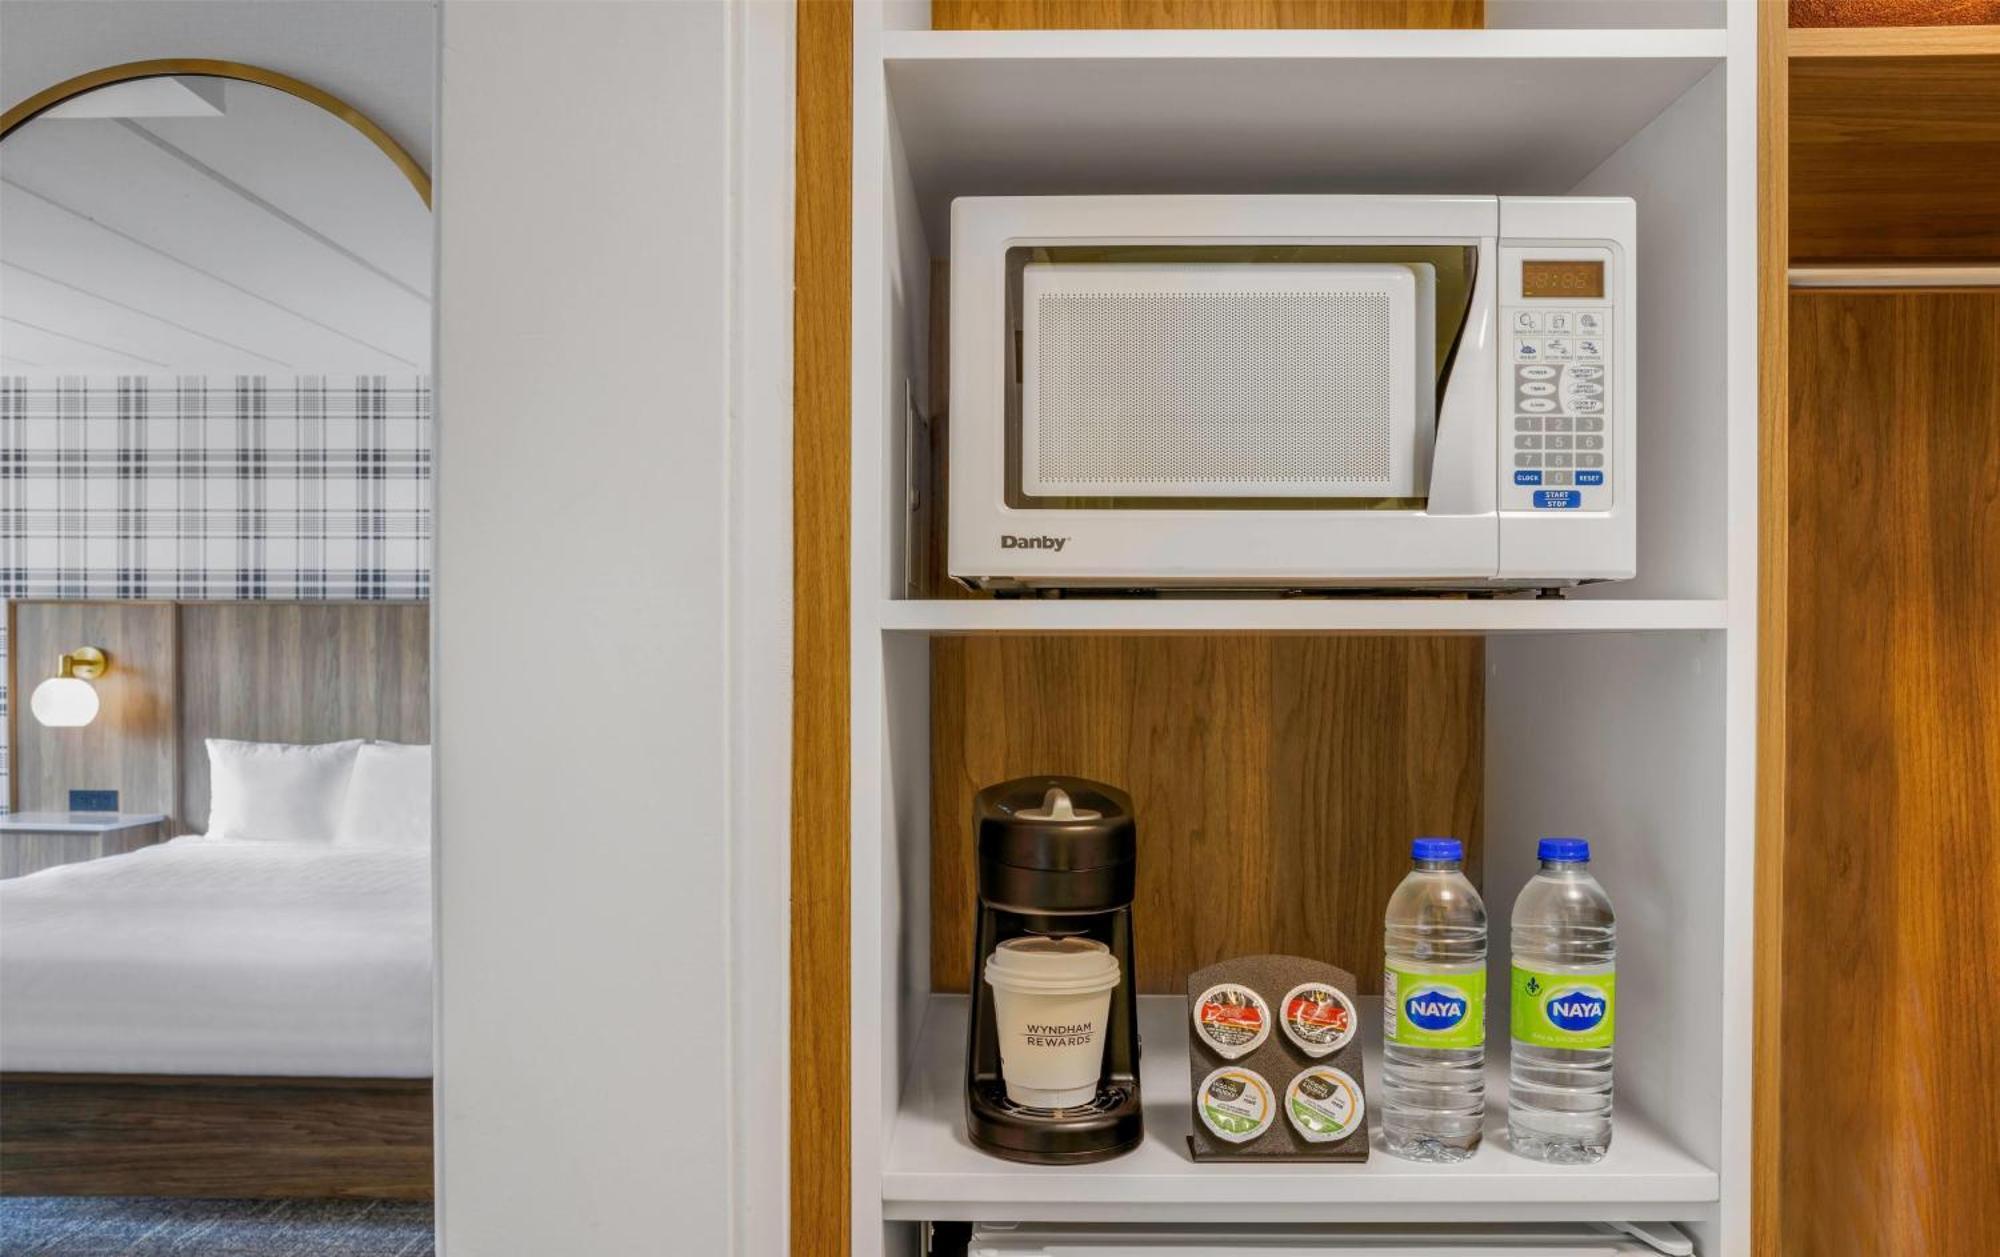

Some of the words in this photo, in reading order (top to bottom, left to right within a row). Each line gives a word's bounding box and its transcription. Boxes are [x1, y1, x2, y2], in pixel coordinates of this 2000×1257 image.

[1001, 535, 1066, 552] Danby
[1411, 1001, 1462, 1017] NAYA
[1552, 1001, 1602, 1018] NAYA
[1026, 1022, 1092, 1035] WYNDHAM
[1027, 1035, 1091, 1047] REWARDS
